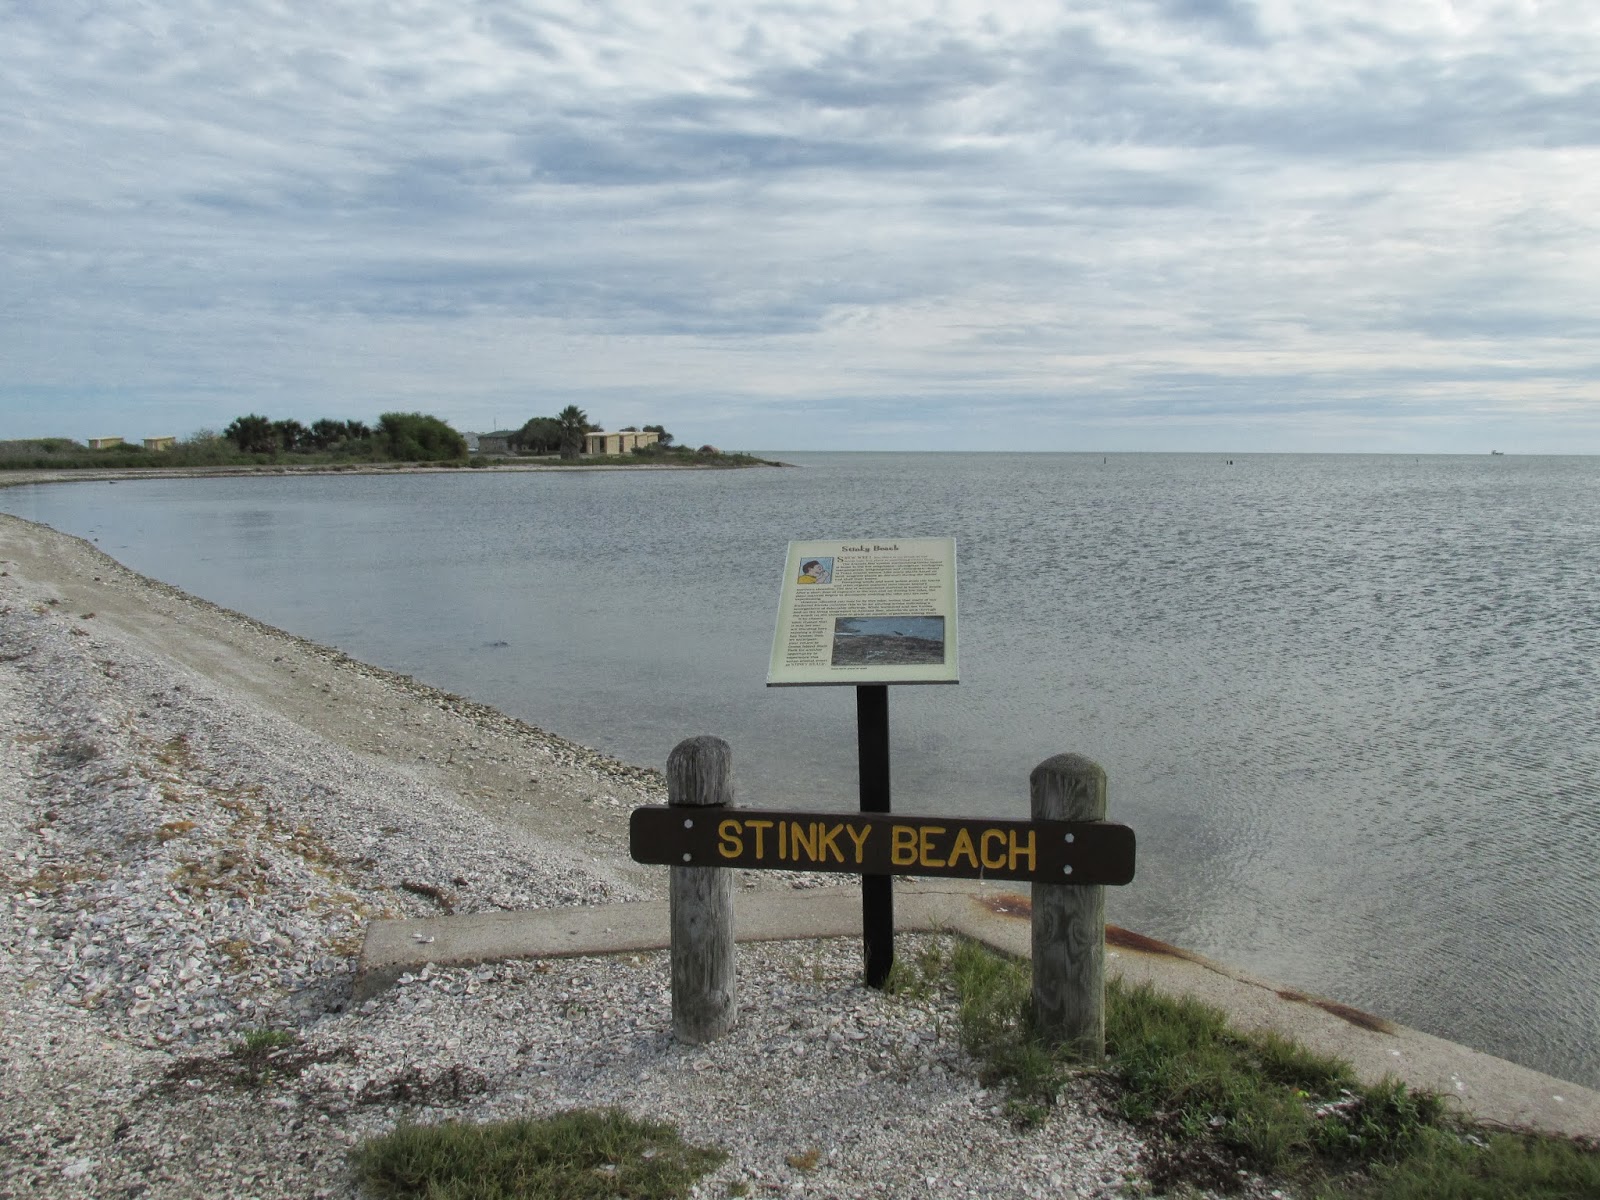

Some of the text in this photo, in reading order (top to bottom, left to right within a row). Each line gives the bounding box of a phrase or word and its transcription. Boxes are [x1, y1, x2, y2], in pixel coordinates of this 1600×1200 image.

[841, 544, 899, 553] Stinky Beach
[718, 819, 1036, 872] STINKY BEACH
